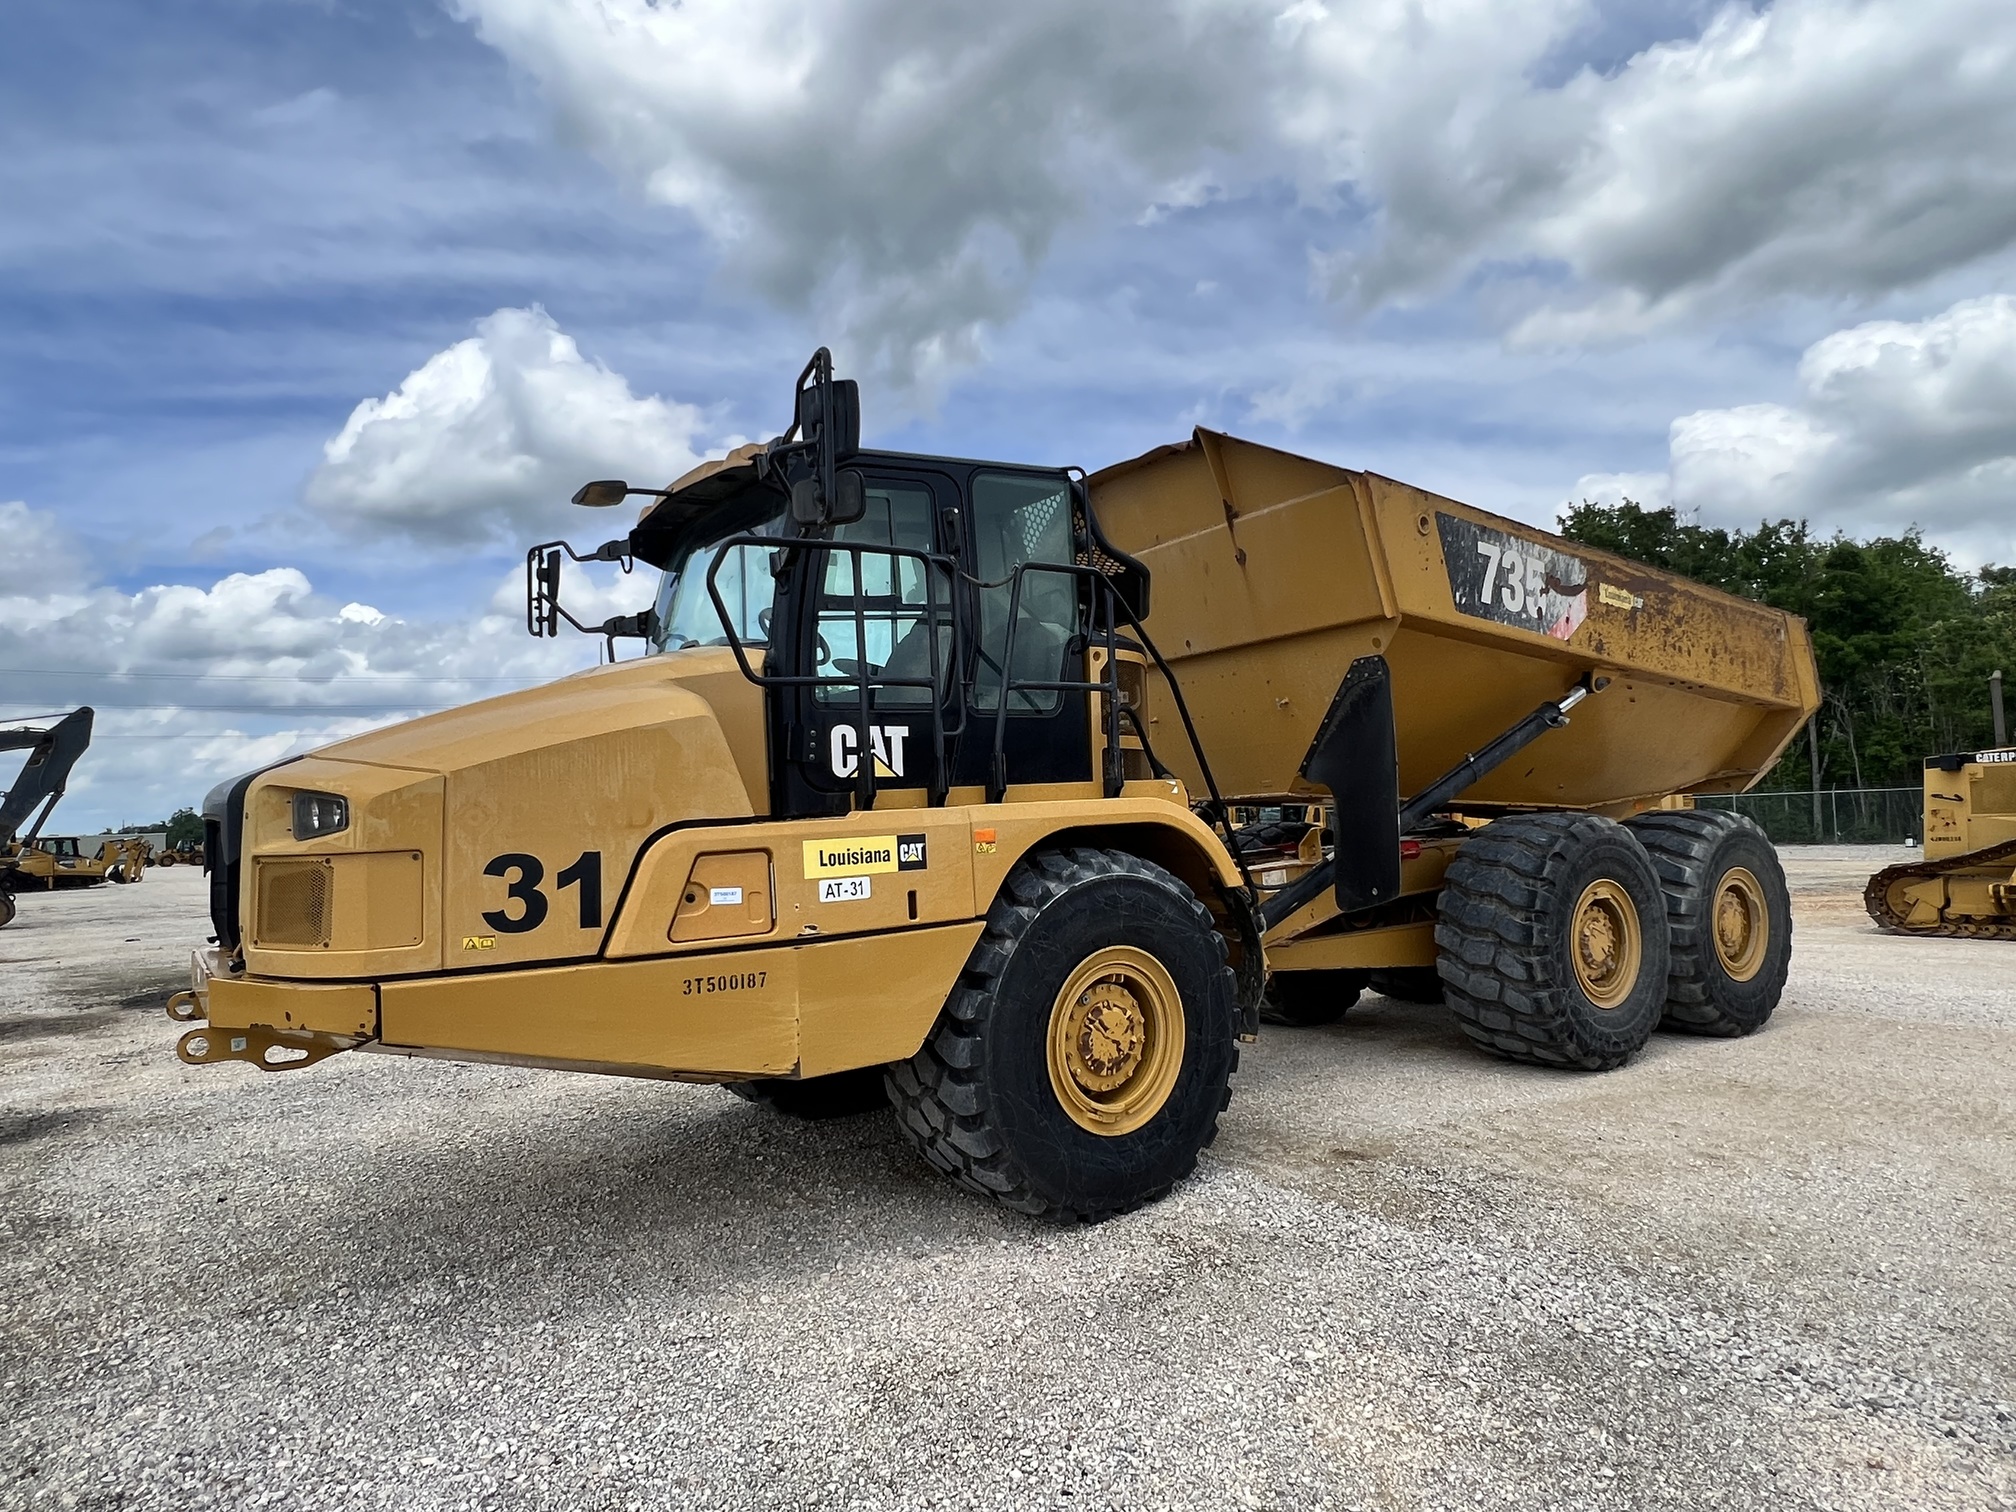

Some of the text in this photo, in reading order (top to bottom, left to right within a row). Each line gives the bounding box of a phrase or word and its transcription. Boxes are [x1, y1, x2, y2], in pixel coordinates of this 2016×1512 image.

[830, 724, 909, 778] CAT
[819, 847, 891, 867] Louisiana
[900, 842, 926, 862] CAT
[481, 851, 602, 933] 31
[825, 880, 864, 899] AT-31
[682, 971, 767, 995] 3T500187
